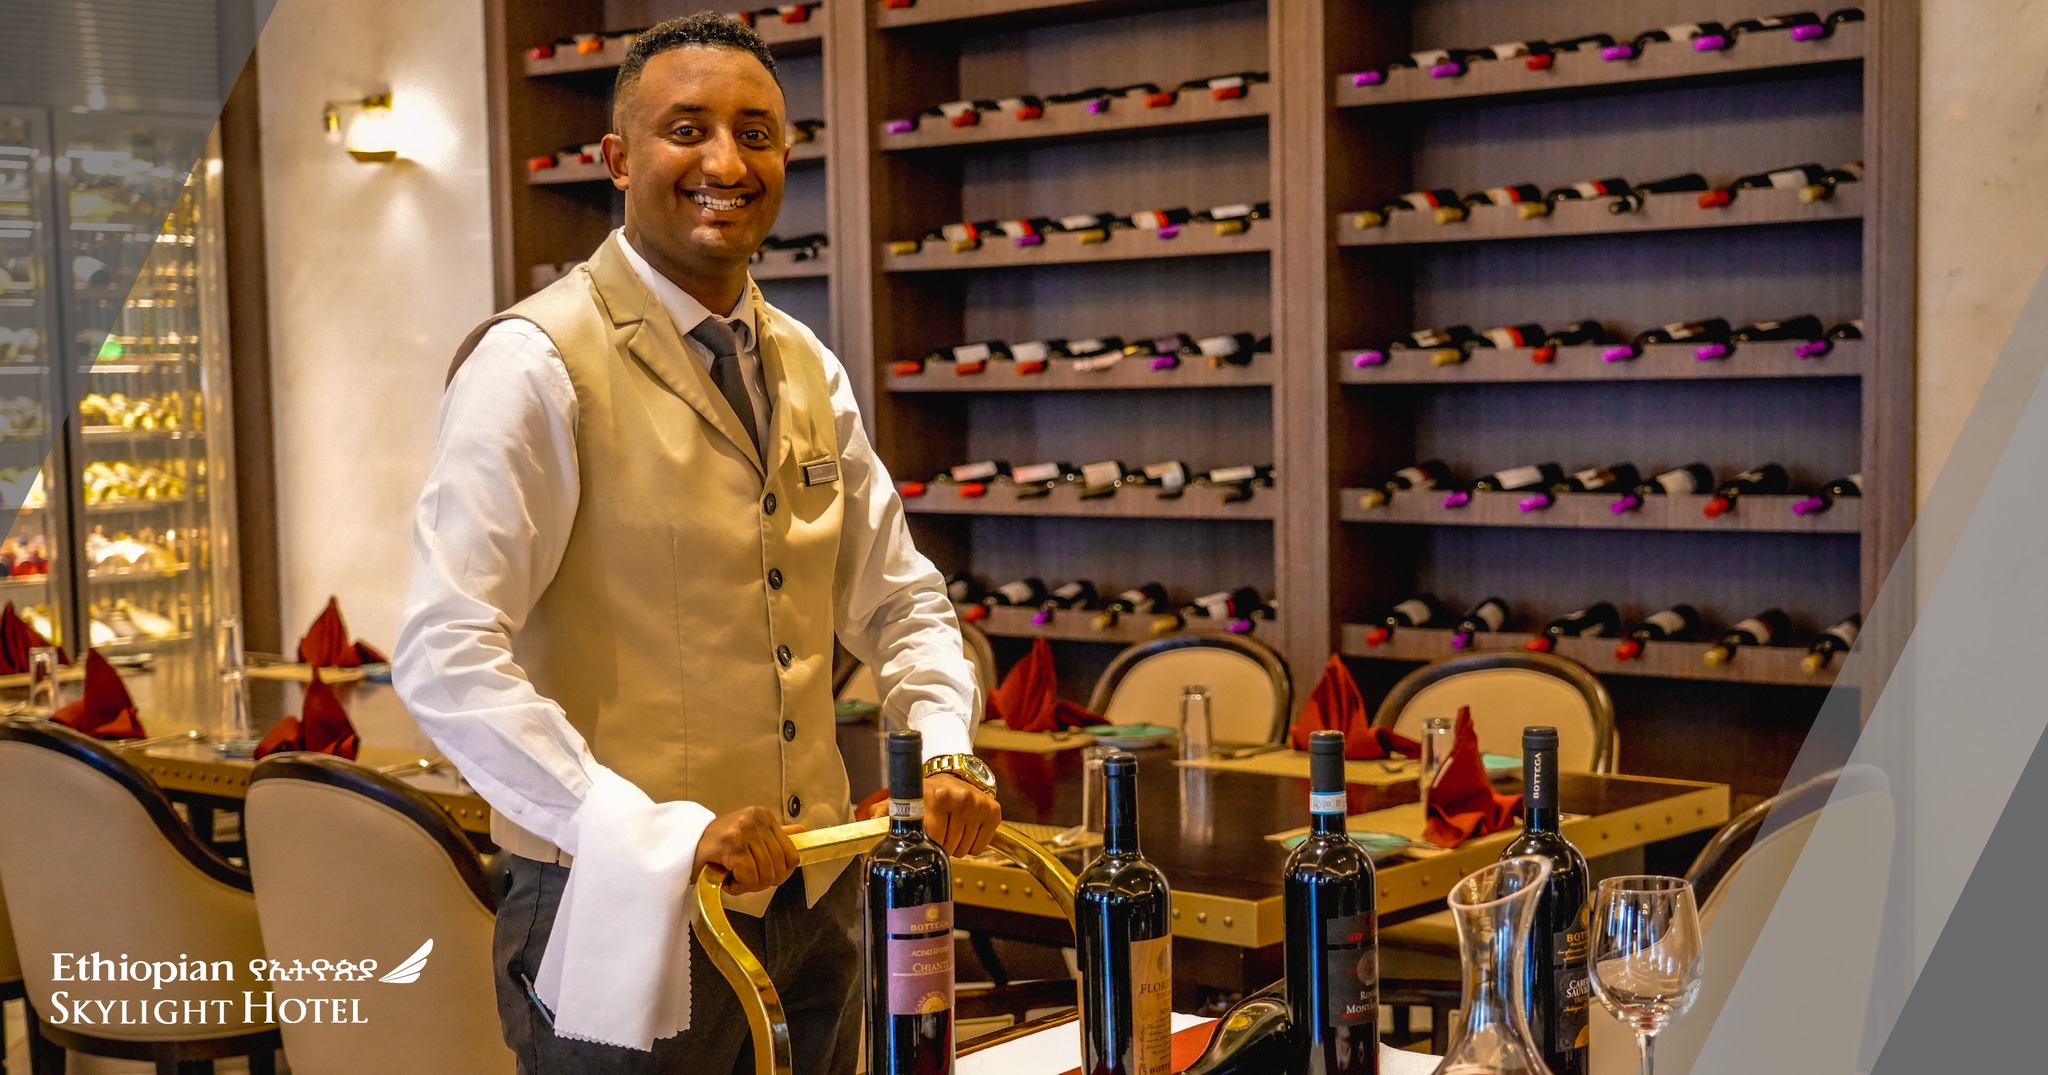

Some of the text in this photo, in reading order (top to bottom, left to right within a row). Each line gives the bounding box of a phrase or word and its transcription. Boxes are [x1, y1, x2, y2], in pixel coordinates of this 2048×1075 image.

[1532, 751, 1542, 799] BOTTEGA
[910, 920, 949, 932] BOTTEGA
[912, 960, 950, 973] CHIANTI
